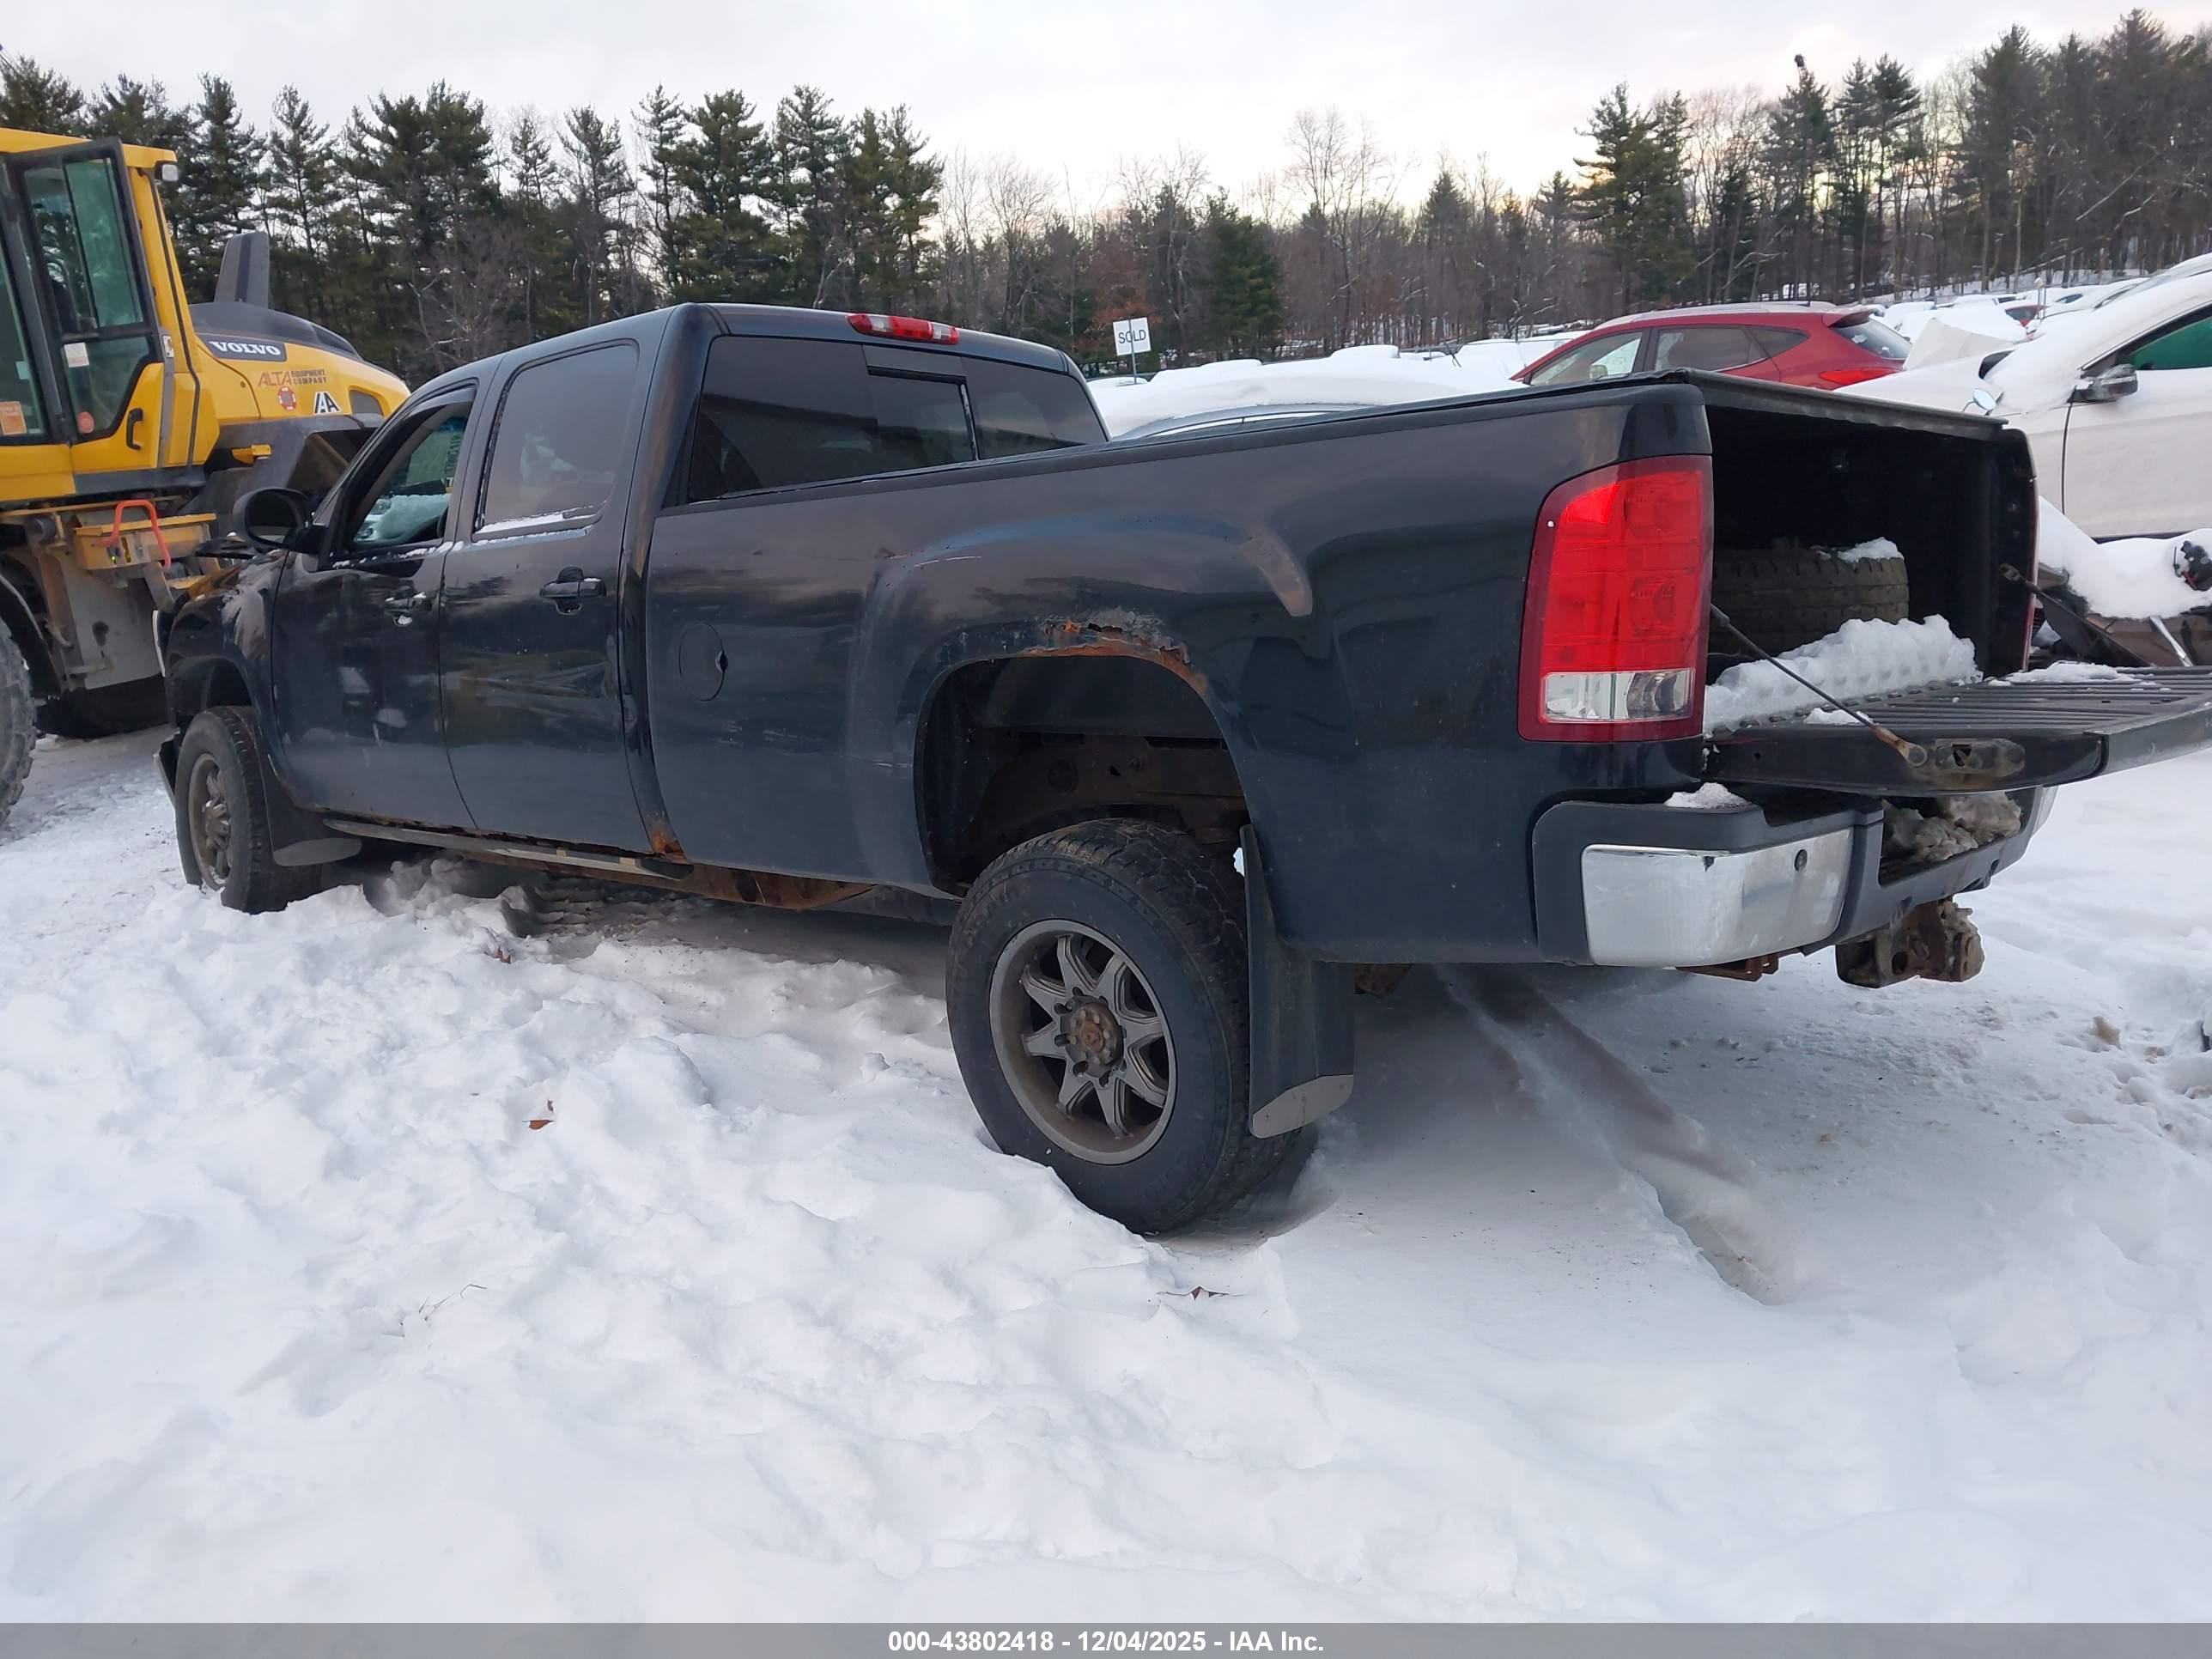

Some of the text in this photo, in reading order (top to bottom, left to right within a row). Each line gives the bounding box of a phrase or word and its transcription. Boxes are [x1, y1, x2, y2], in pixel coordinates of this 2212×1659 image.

[1118, 329, 1146, 343] SOLD
[209, 341, 281, 356] VOLVO
[258, 371, 292, 386] ALTA
